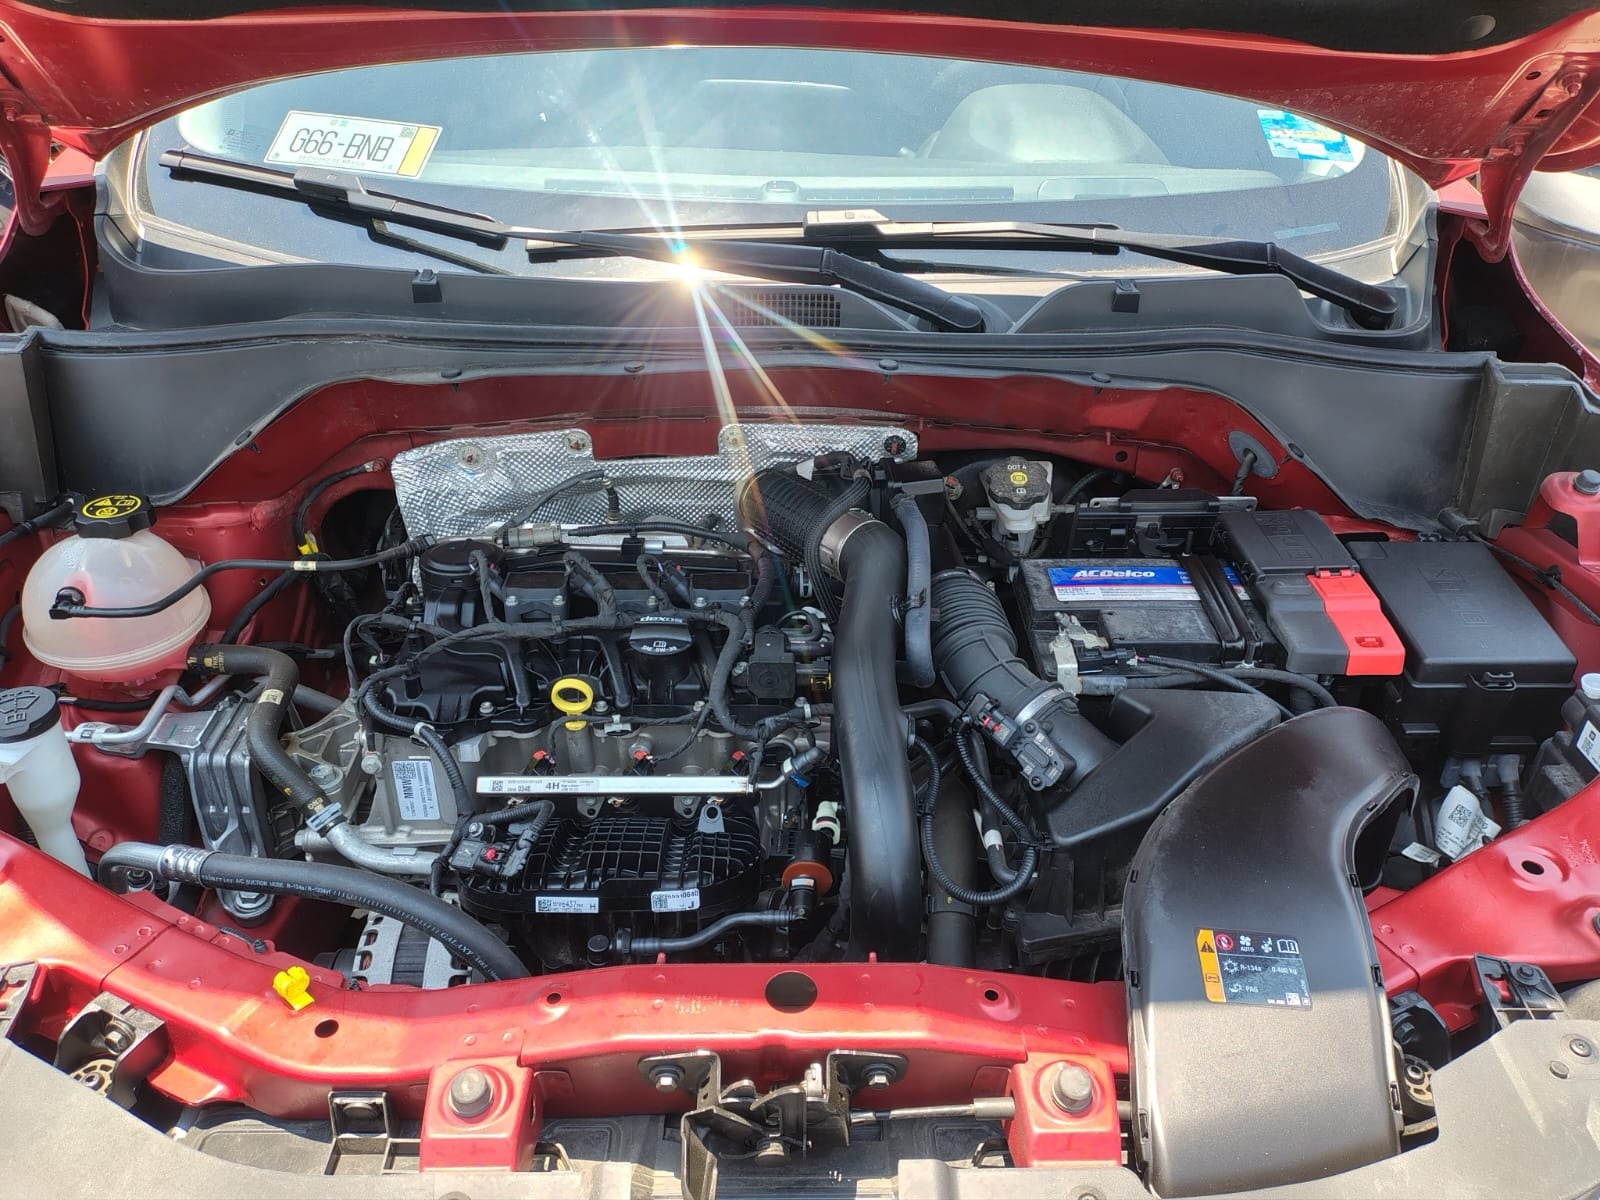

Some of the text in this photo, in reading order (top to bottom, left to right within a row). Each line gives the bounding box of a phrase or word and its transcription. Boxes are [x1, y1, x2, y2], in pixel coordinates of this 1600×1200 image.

[289, 127, 395, 162] G66-BNB
[1072, 569, 1156, 578] ACDelco
[440, 932, 475, 956] GALAXY
[1245, 985, 1259, 993] PAG
